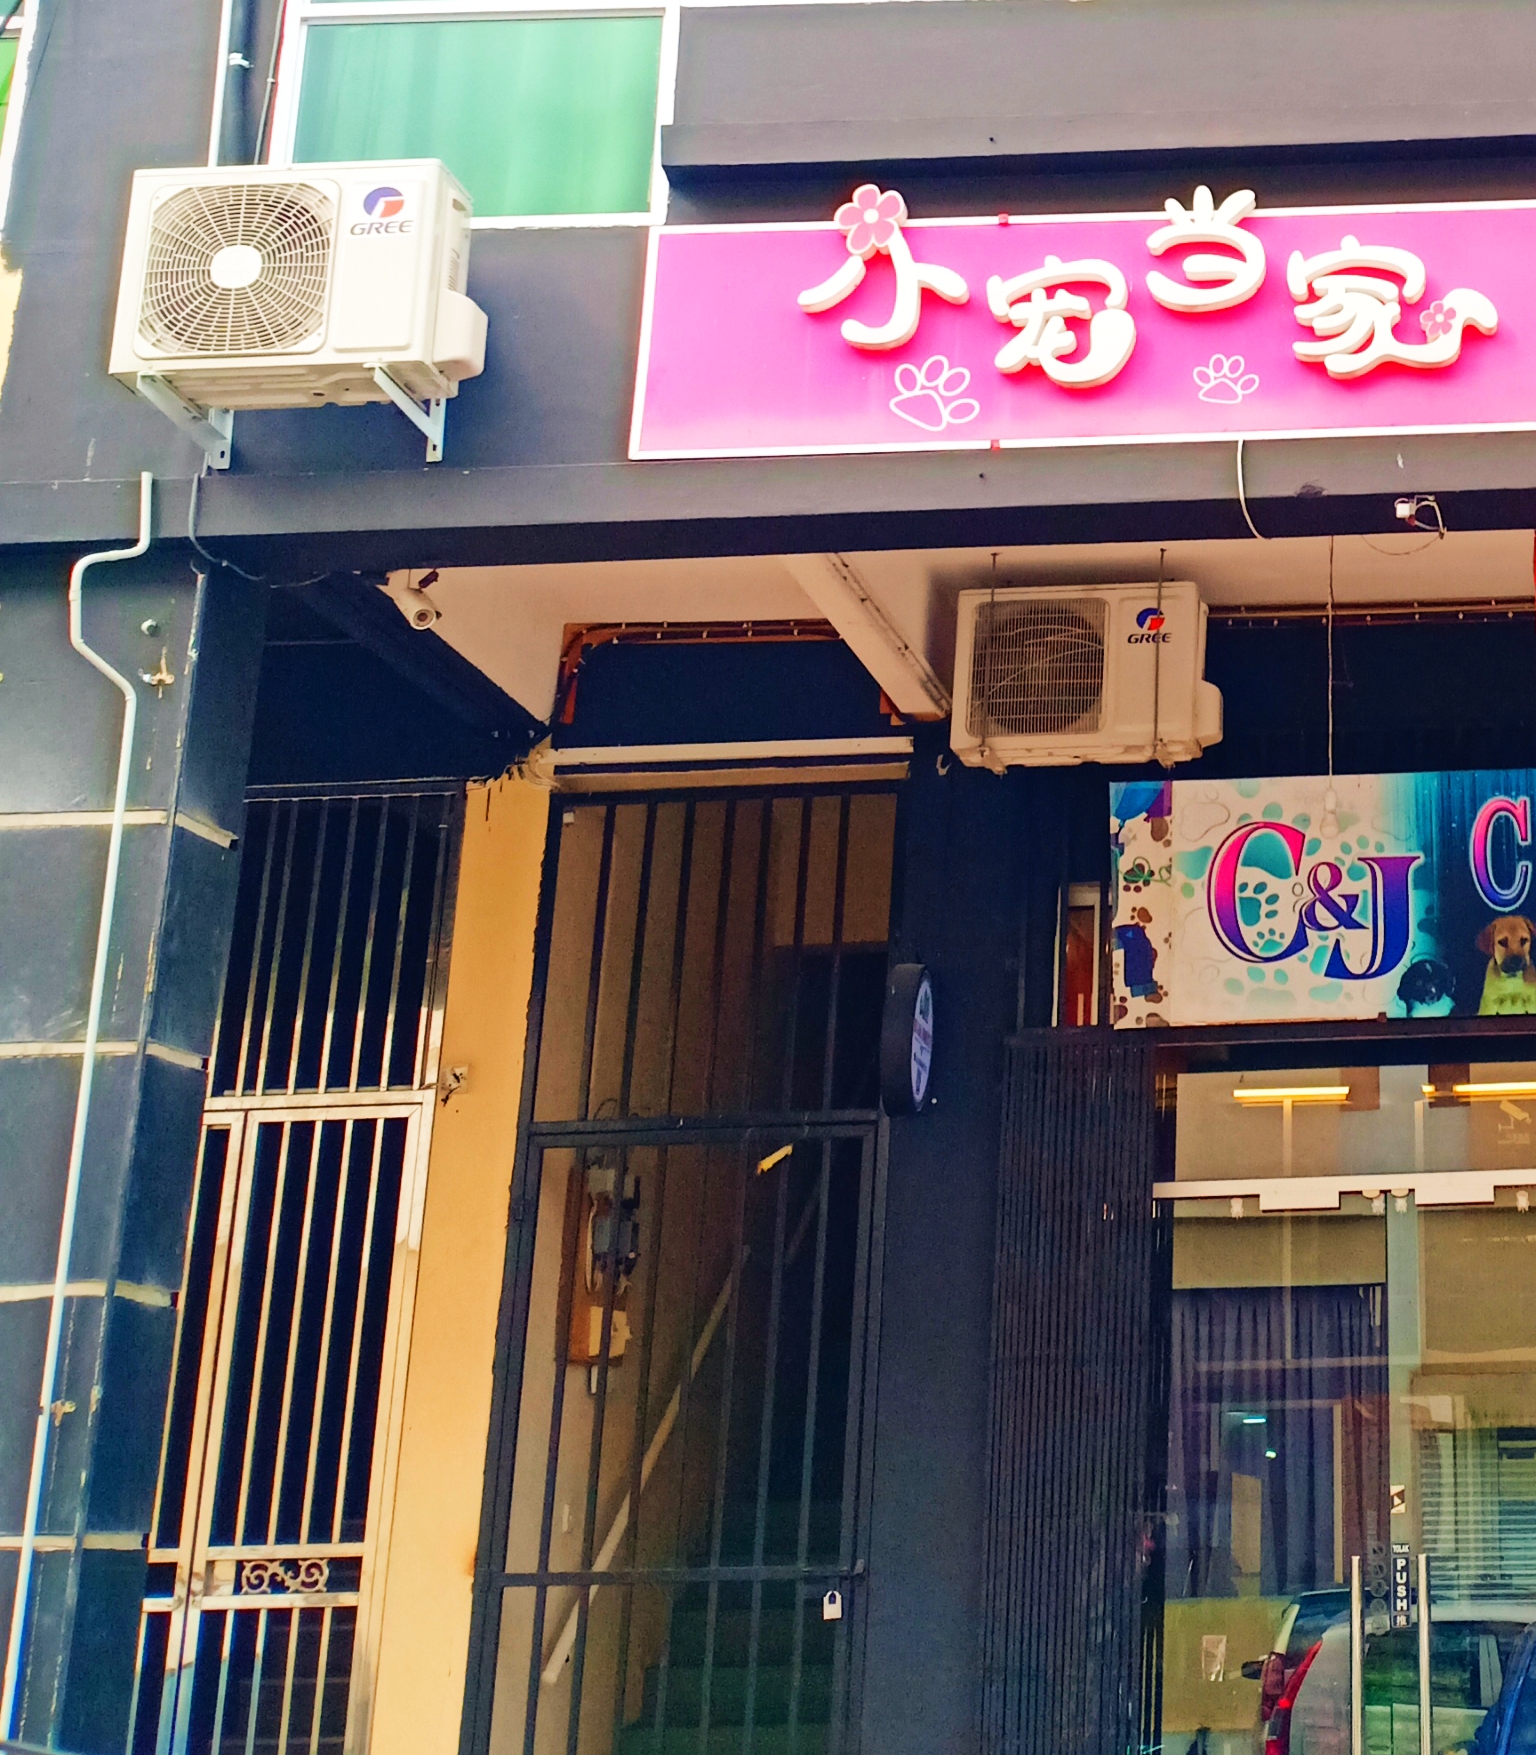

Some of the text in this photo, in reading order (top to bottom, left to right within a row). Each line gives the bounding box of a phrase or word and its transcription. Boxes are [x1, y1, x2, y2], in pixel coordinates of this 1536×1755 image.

[350, 219, 414, 237] GREE
[797, 183, 1500, 391] 小宠当家
[1127, 632, 1172, 644] GREE
[1469, 796, 1533, 911] C
[1206, 821, 1424, 981] C&J
[1395, 1558, 1408, 1612] PUSH
